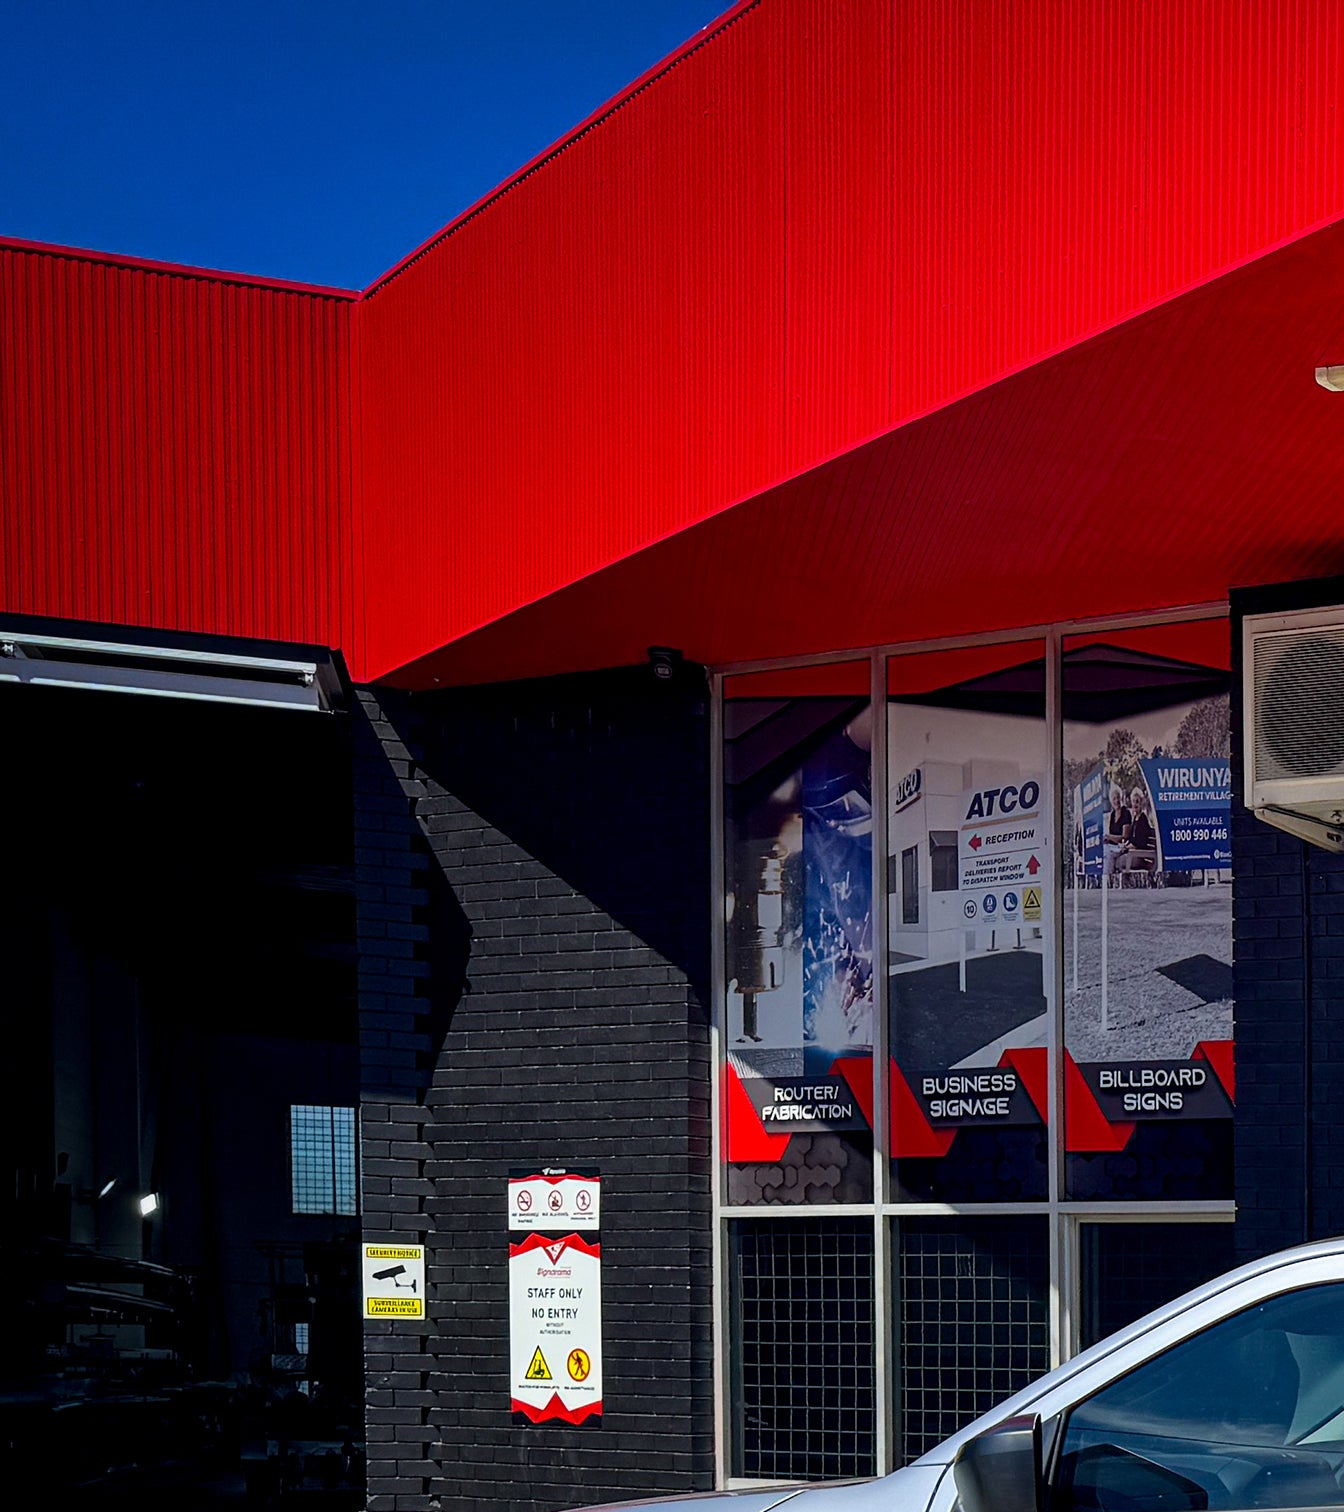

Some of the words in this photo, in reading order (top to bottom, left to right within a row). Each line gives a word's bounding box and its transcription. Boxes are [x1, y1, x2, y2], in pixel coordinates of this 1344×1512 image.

[966, 781, 1040, 820] ATCO
[1158, 792, 1203, 801] RETIREMENT
[1174, 817, 1191, 826] UNITS
[1193, 816, 1223, 825] AVAILABLE
[985, 829, 1035, 845] RECEPTION
[1170, 829, 1191, 841] 1800
[976, 857, 1009, 867] TRANSPORT
[965, 867, 996, 877] DELIVERIES
[998, 864, 1022, 873] REPORT
[971, 875, 998, 885] DISPATCH
[1000, 873, 1025, 881] WINDOW
[922, 1074, 1016, 1095] BUSINESS
[1100, 1068, 1206, 1089] BILLBOARD
[774, 1086, 839, 1102] ROUTER/
[930, 1097, 1010, 1117] SIGNAGE
[1123, 1092, 1183, 1111] SIGNS
[762, 1104, 852, 1120] FABRICATION
[527, 1287, 555, 1299] STAFF
[558, 1287, 583, 1299] ONLY
[531, 1308, 545, 1319] NO
[547, 1308, 578, 1319] ENTRY
